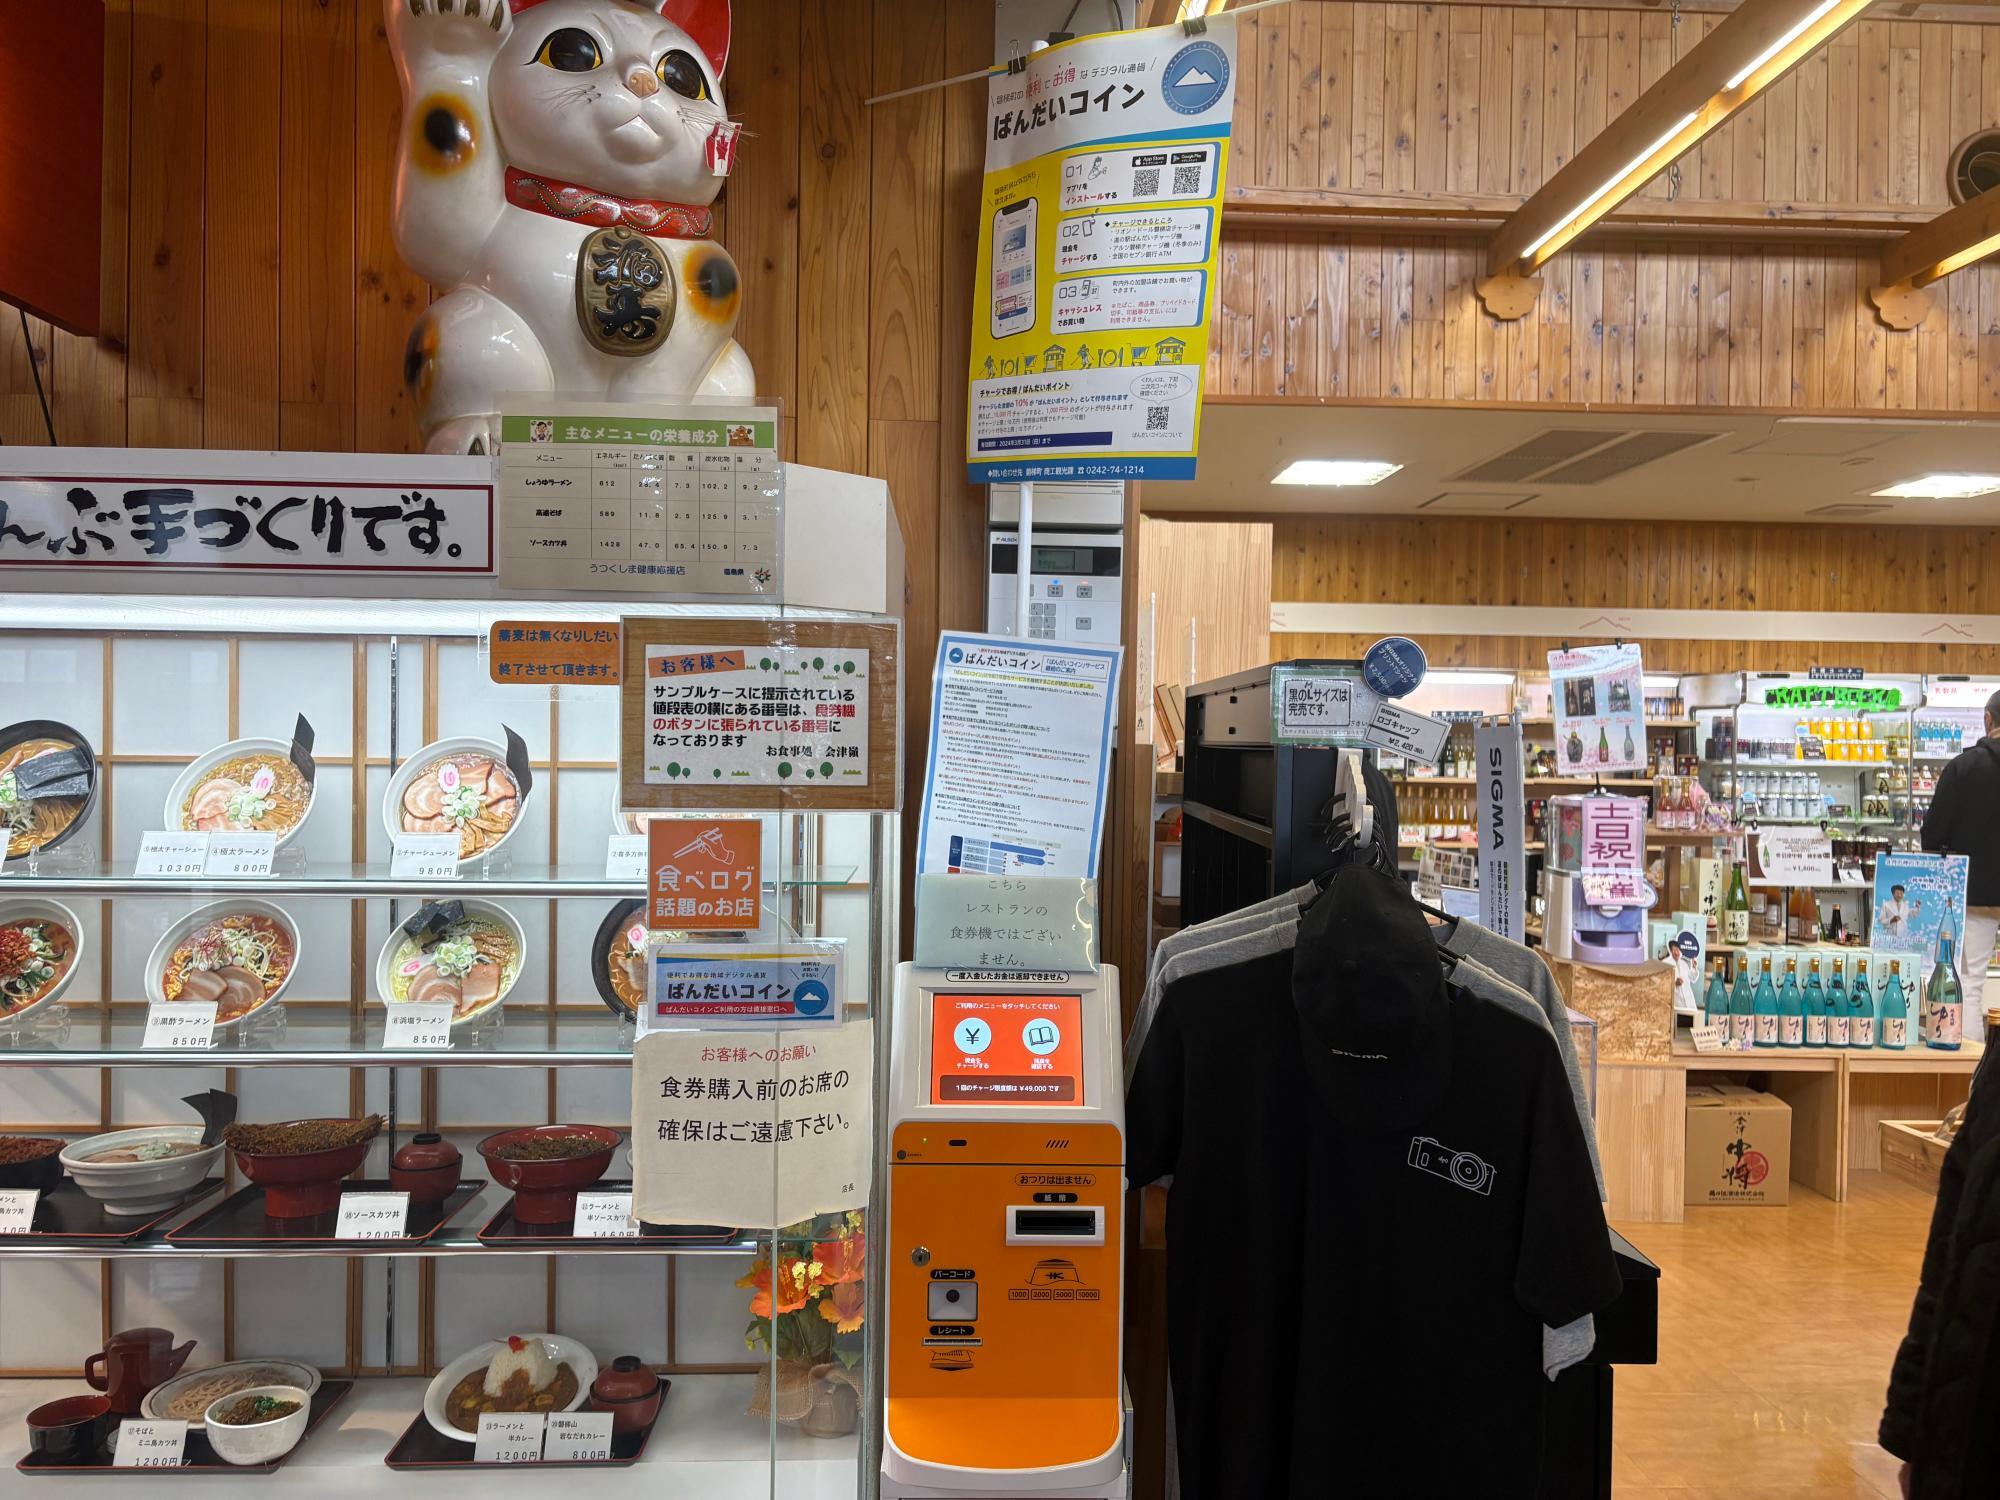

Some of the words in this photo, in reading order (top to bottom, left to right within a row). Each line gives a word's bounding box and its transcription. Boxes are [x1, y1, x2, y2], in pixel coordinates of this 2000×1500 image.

[993, 84, 1145, 140] ばんだいコイン
[1066, 165, 1082, 177] 01
[1066, 183, 1088, 193] アプリを
[1066, 192, 1117, 204] インストールする
[1063, 225, 1079, 237] 02
[1062, 254, 1097, 265] チャージする
[1059, 286, 1077, 298] 03
[1058, 304, 1102, 316] キャッシュレス
[1057, 318, 1085, 327] でお買い物
[565, 425, 720, 445] 主なメニューの栄養成分
[535, 454, 563, 463] メニュー
[595, 452, 627, 460] エネルギー
[1086, 465, 1144, 475] 0242-74-1214
[525, 478, 573, 487] しょうゆラーメン
[590, 564, 685, 576] うつくしま健康応援店
[661, 655, 735, 674] お客様へ
[965, 653, 1040, 671] ばんだいコイン
[498, 663, 618, 678] 終了させて頂きます。
[653, 686, 855, 701] サンプルケースに提示されている
[1289, 688, 1348, 703] 黒のLサイズは
[1765, 686, 1833, 709] CRAFT
[1289, 703, 1328, 717] 完売です。
[1381, 707, 1401, 719] SIGMA
[653, 718, 841, 734] のボタンに張られている番号に
[1377, 716, 1420, 735] ロゴキャップ
[652, 734, 747, 747] なっております
[766, 745, 813, 757] お食事処
[1489, 748, 1504, 850] SIGMA
[158, 864, 200, 872] 1030円
[234, 864, 267, 872] 800円
[655, 864, 754, 894] 食べログ
[987, 879, 1027, 892] こちら
[655, 897, 754, 918] 話題のお店
[966, 902, 1048, 917] レストランの
[950, 926, 1062, 942] 食券機ではござい
[978, 952, 1025, 968] ません。
[952, 972, 1064, 981] 一度入金したお金は返却できません
[668, 983, 791, 1000] ばんだいコイン
[172, 1037, 207, 1045] 850円
[413, 1036, 446, 1044] 850円
[701, 1044, 816, 1063] お客様へのお願い
[660, 1069, 849, 1101] 食券購入前のお席の
[658, 1111, 850, 1144] 確保はご遠慮下さい。
[1020, 1175, 1091, 1185] おつりは出ません
[934, 1271, 971, 1279] バーコード
[135, 1458, 177, 1466] 1200円
[496, 1452, 537, 1460] 1200円
[573, 1451, 606, 1459] 800円
